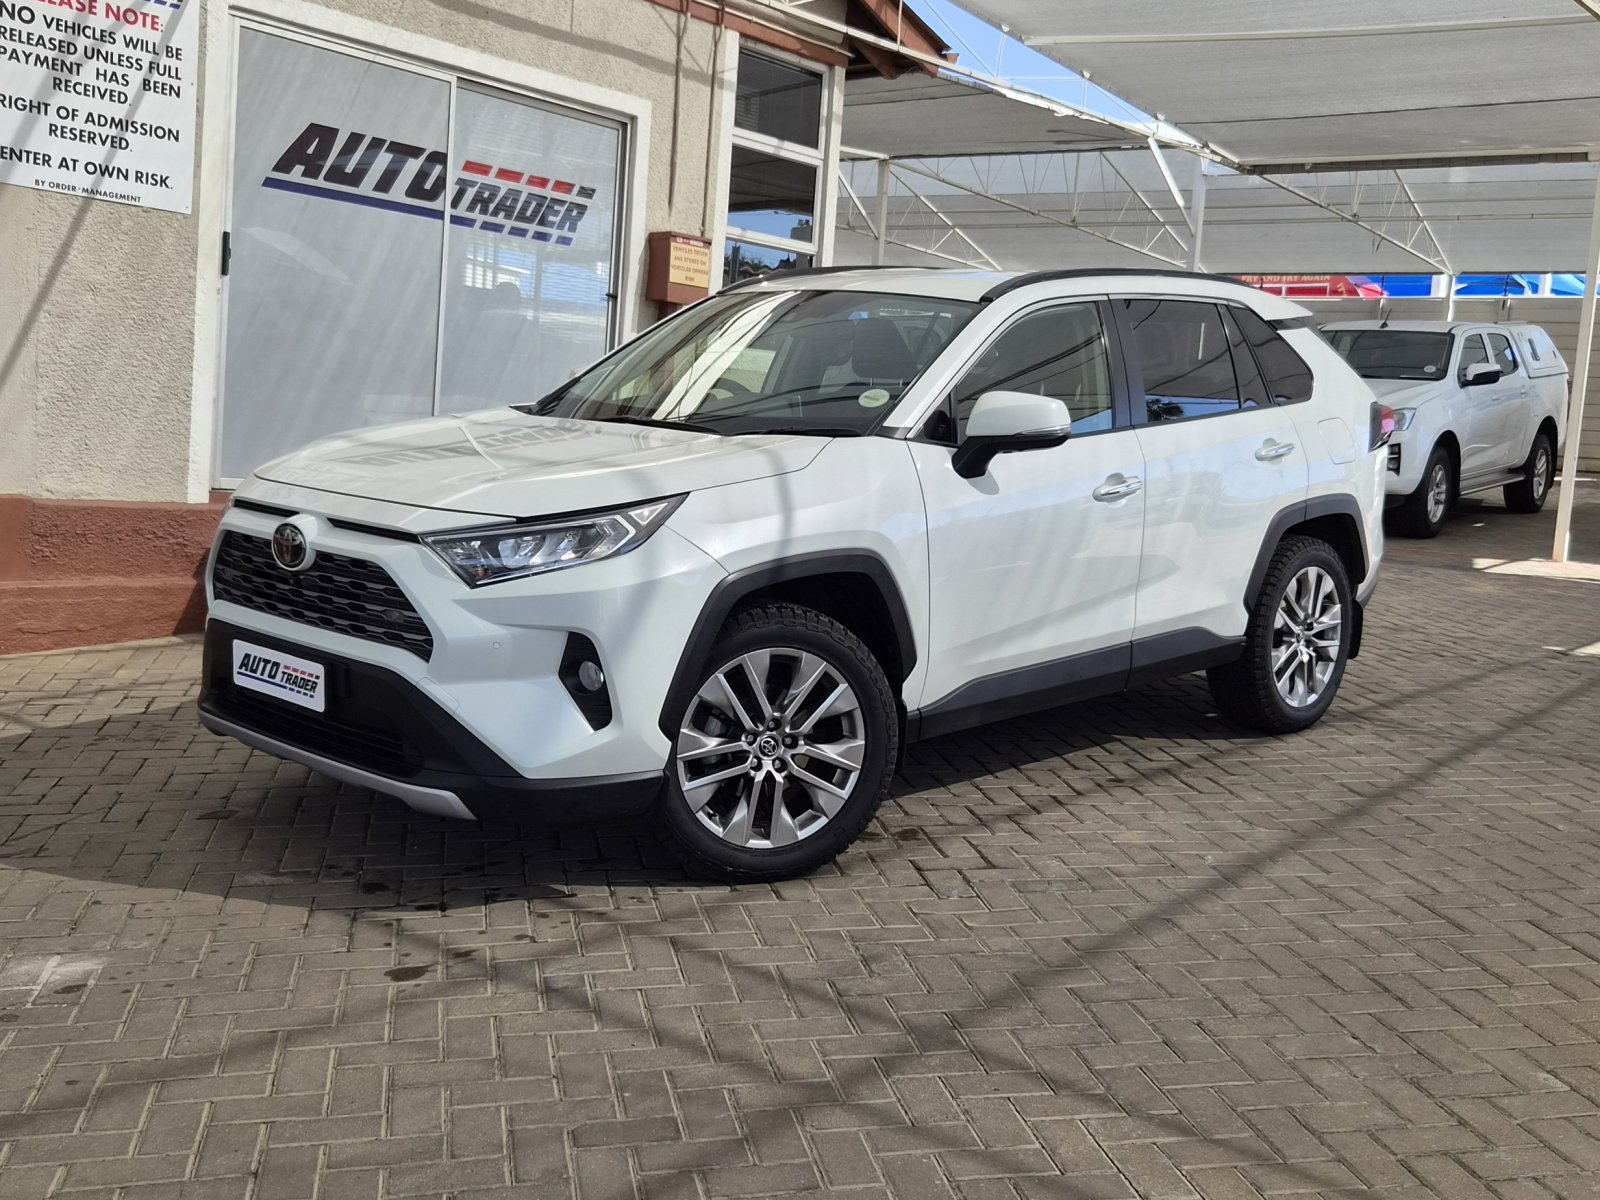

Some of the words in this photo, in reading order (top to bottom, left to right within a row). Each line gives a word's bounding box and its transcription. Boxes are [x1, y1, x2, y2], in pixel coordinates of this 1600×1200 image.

[0, 1, 36, 25] NO
[43, 14, 117, 45] VEHICLES
[123, 34, 159, 56] WILL
[165, 45, 183, 61] BE
[105, 3, 164, 32] NOTE:
[0, 25, 78, 55] RELEASED
[84, 45, 143, 71] UNLESS
[149, 61, 182, 81] FULL
[53, 76, 131, 106] RECEIVED.
[96, 67, 130, 87] HAS
[142, 78, 181, 99] BEEN
[0, 93, 51, 116] RIGHT
[56, 105, 79, 121] OF
[84, 112, 180, 142] ADMISSION
[49, 122, 133, 152] RESERVED.
[0, 145, 52, 168] ENTER
[57, 156, 79, 172] AT
[84, 161, 129, 182] OWN
[135, 170, 173, 189] RISK.
[271, 122, 447, 203] AUTO
[450, 177, 589, 233] TRADER
[34, 178, 46, 187] BY
[81, 187, 141, 203] MANAGEMENT
[238, 652, 281, 680] AUTO
[279, 671, 319, 694] TRADER
